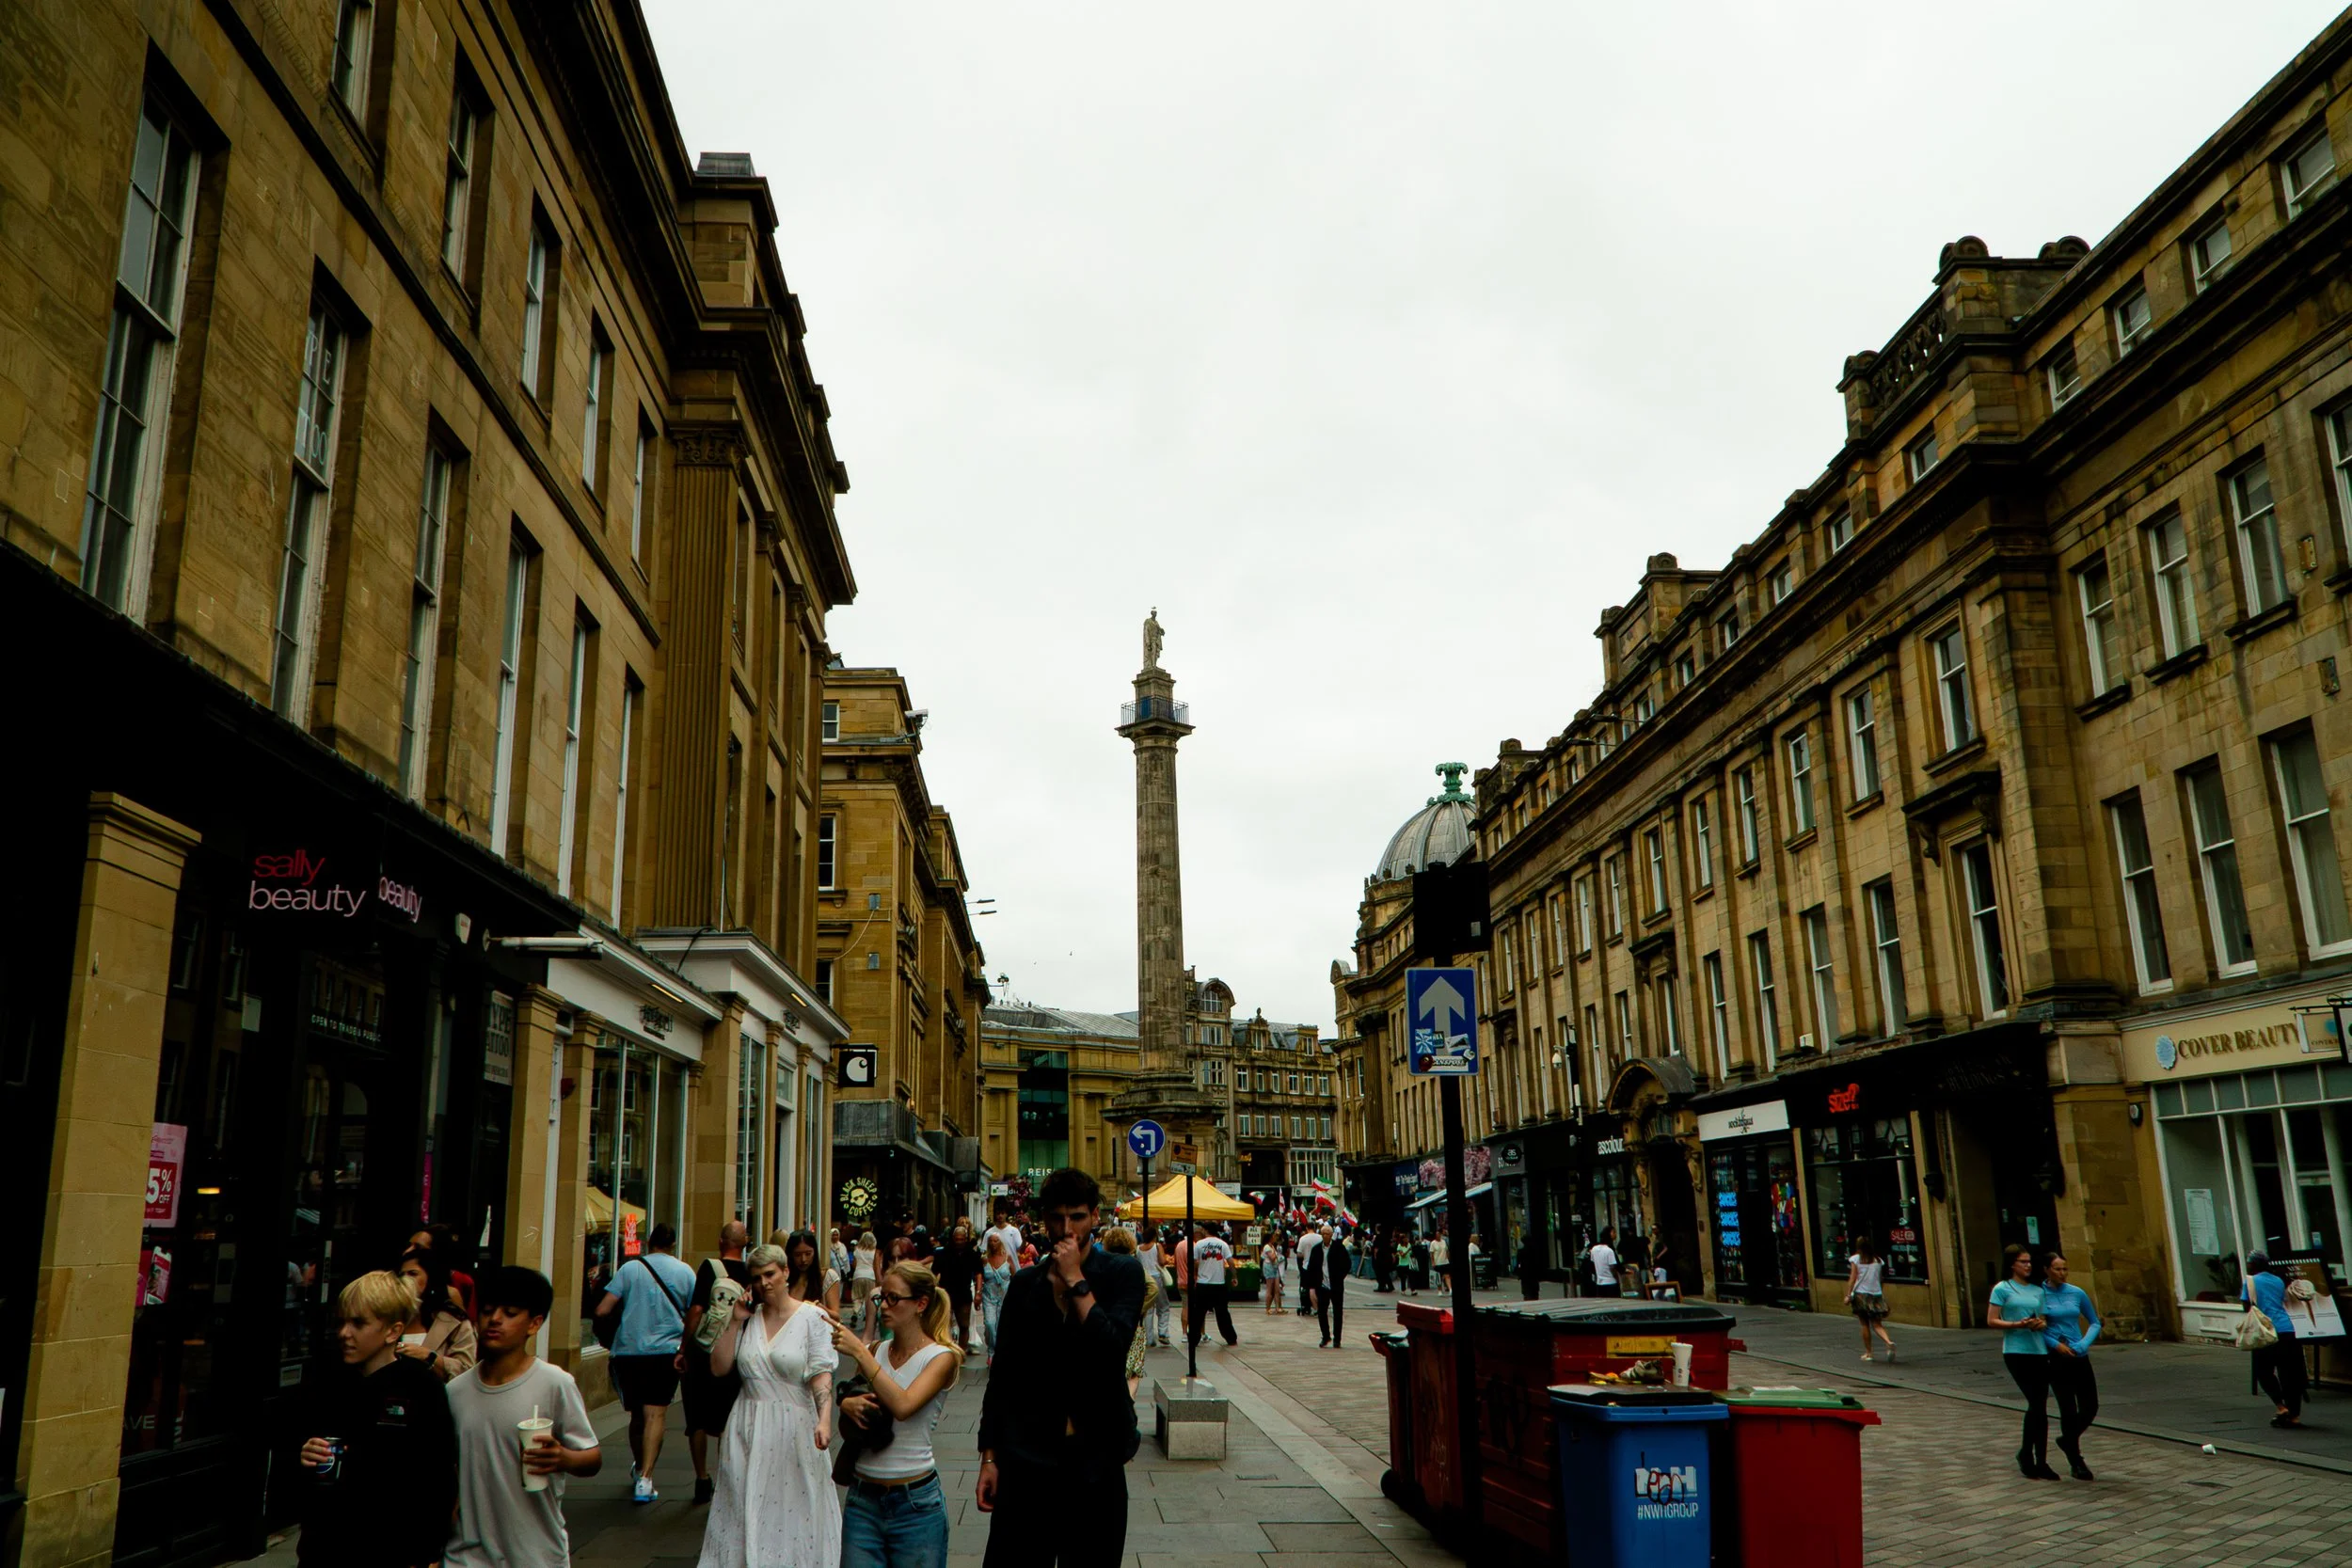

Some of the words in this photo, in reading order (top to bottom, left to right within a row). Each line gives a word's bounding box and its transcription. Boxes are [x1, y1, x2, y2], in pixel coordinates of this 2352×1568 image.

[253, 848, 326, 886] sally
[248, 880, 367, 918] beauty
[378, 876, 423, 924] beauty
[2178, 1035, 2233, 1059] COVER
[2235, 1023, 2299, 1050] BEAUTY
[1828, 1083, 1861, 1114] size?
[1027, 1167, 1055, 1177] REIS
[839, 1178, 857, 1202] BLACK
[856, 1176, 878, 1194] SHEEP
[848, 1199, 878, 1217] COFFEE
[1890, 1229, 1905, 1241] SALE
